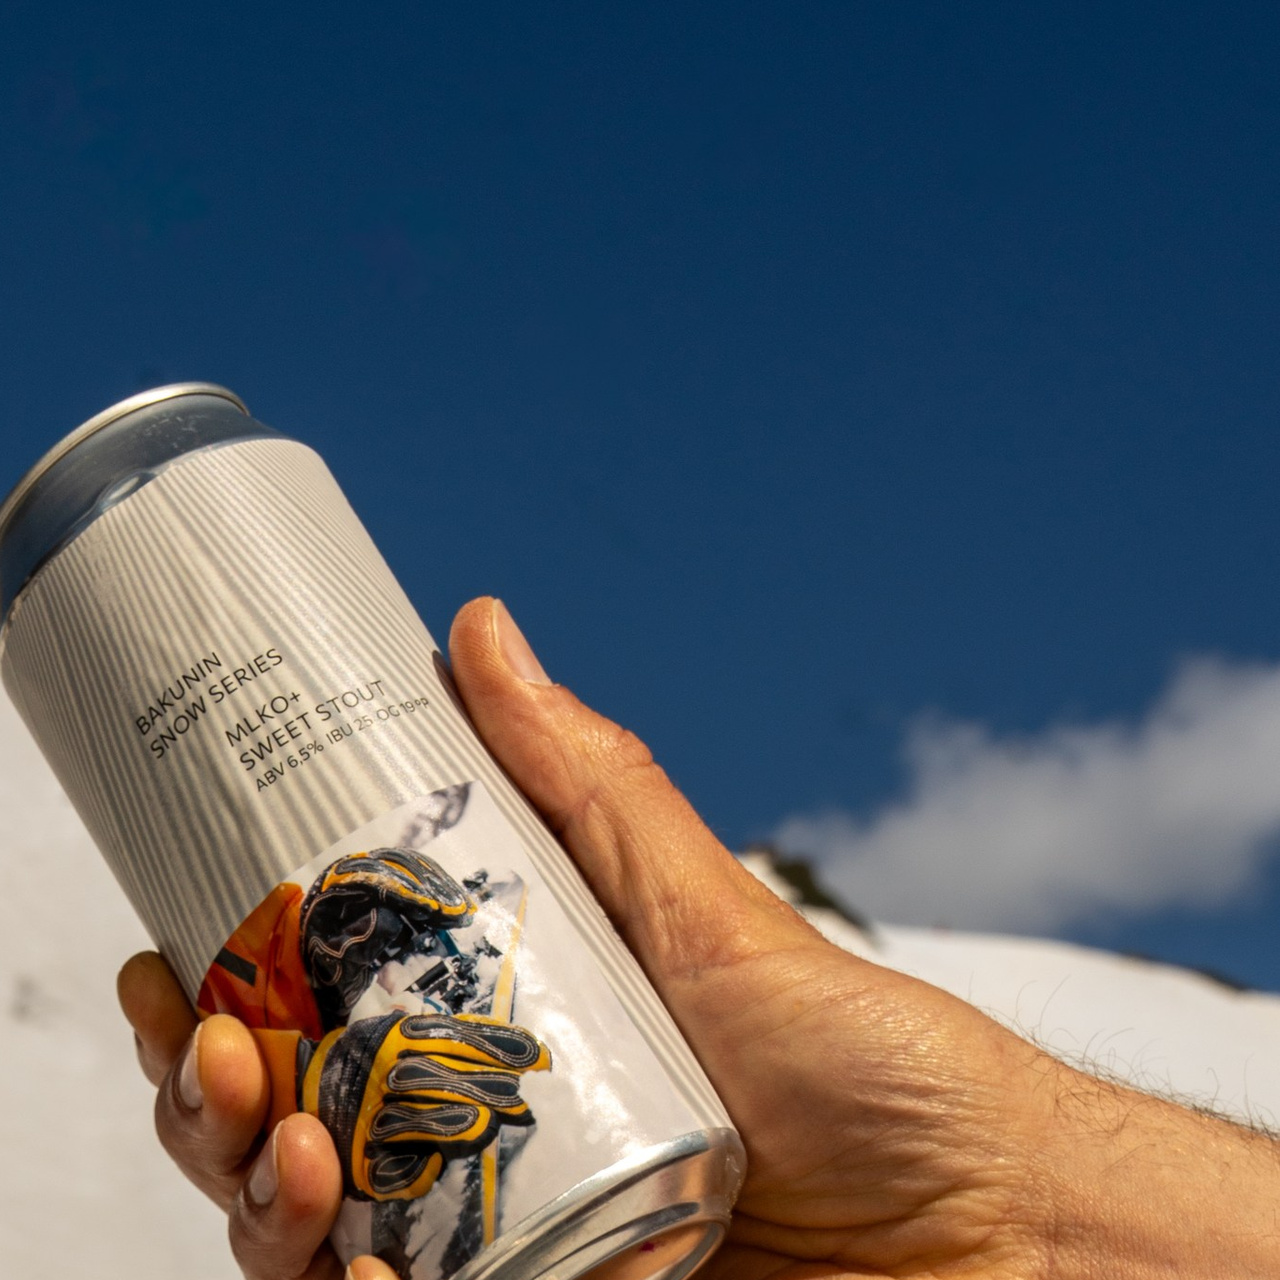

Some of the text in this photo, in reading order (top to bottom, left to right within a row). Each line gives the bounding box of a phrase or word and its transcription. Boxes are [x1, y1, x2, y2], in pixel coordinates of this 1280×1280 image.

[135, 652, 223, 735] BAKUNIN
[150, 649, 283, 758] SNOW SERIES
[225, 691, 301, 746] MLKO+
[239, 680, 388, 771] SWEET STOUT
[256, 765, 286, 791] ABV
[286, 740, 324, 769] 6,5%
[326, 724, 353, 745] IBU
[354, 715, 373, 731] 25
[377, 705, 400, 723] OG
